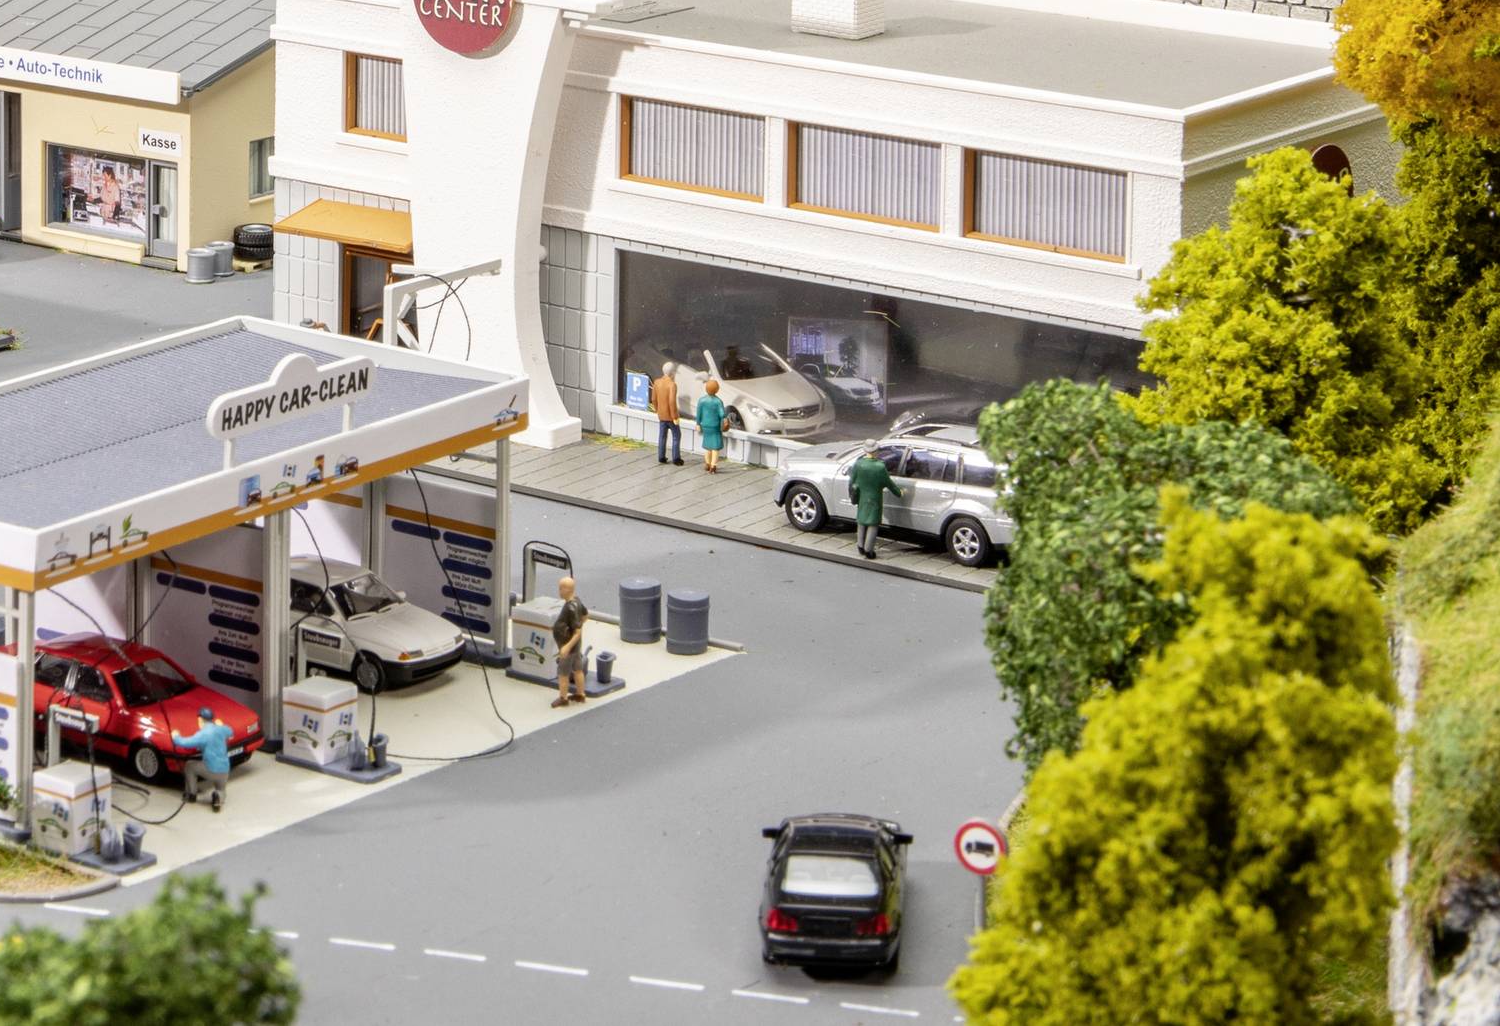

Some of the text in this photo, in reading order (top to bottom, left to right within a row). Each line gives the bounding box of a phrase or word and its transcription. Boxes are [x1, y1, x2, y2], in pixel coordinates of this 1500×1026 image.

[16, 57, 103, 84] Auto-Technik
[142, 133, 177, 150] Kasse
[632, 377, 641, 391] P
[221, 367, 369, 432] HAPPY CAR-CLEAN
